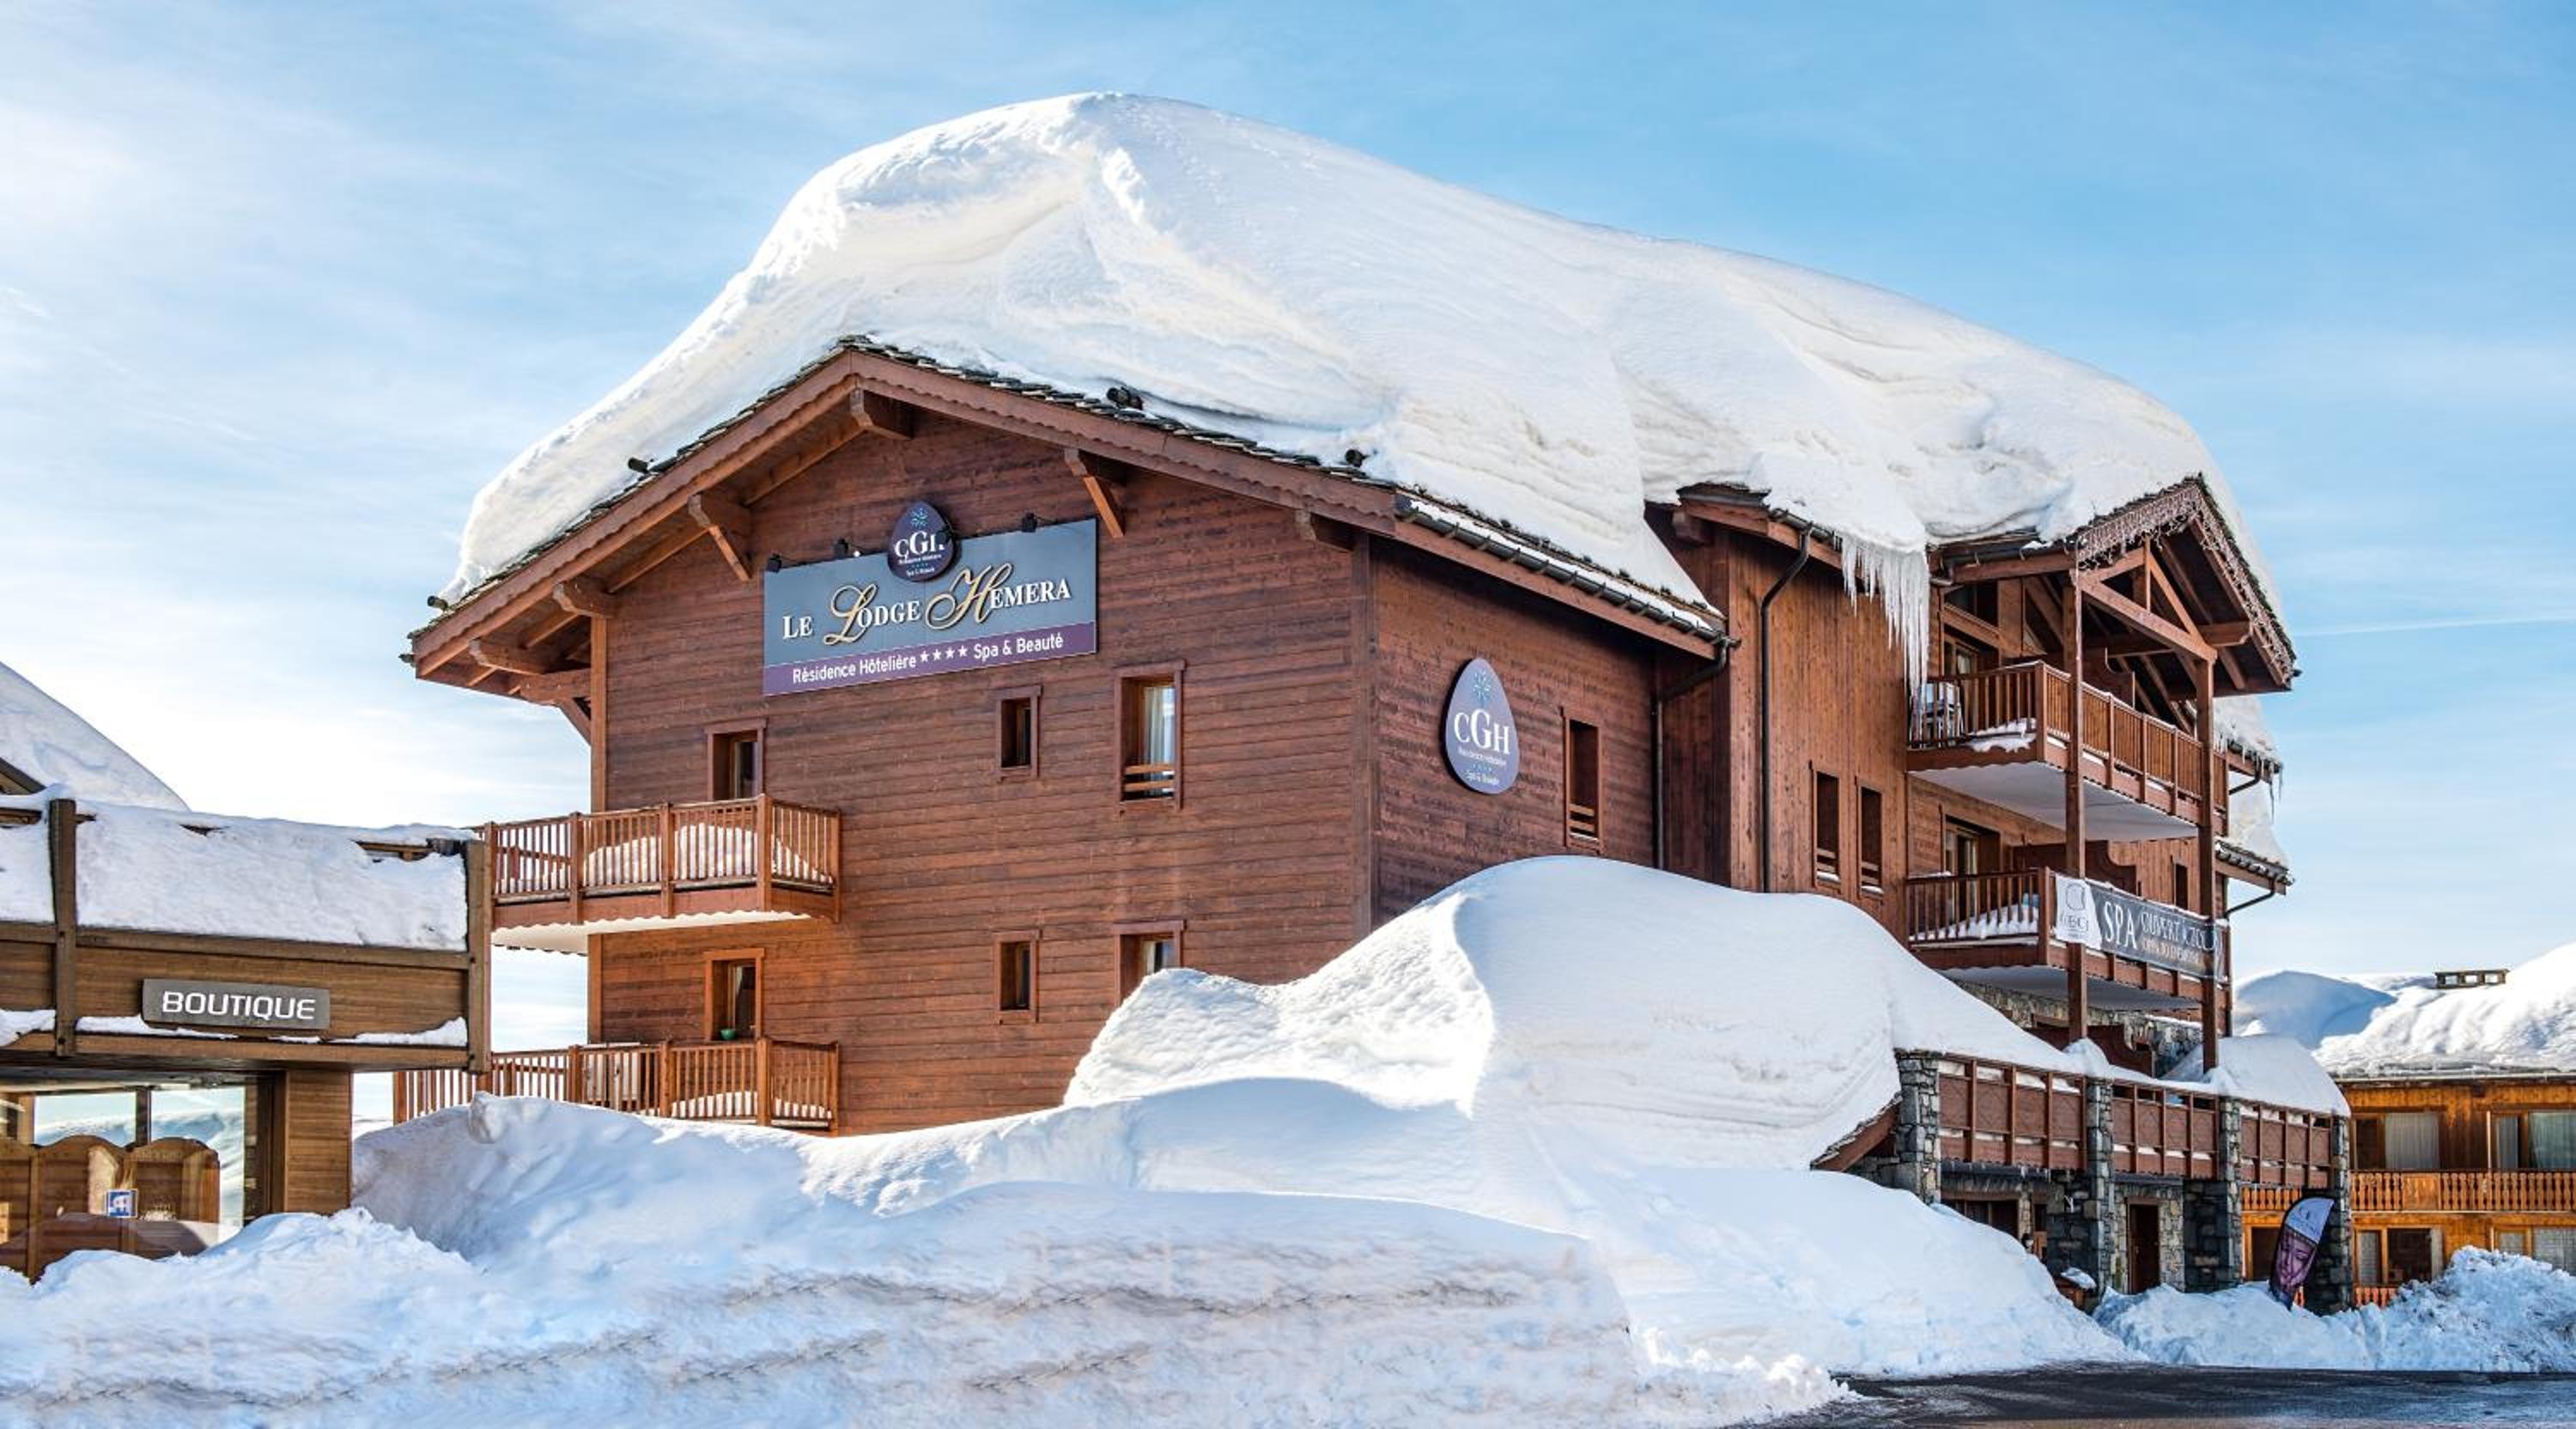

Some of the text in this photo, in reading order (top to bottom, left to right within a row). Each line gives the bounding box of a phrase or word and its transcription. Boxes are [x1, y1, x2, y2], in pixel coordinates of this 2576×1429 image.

[782, 562, 1072, 645] LE LODGE HEMERA
[793, 632, 1064, 684] Résidence Hôtelière Spa & Beauté
[1454, 708, 1510, 755] CGH
[2104, 902, 2137, 950] SPA
[162, 990, 317, 1020] BOUTIQUE
